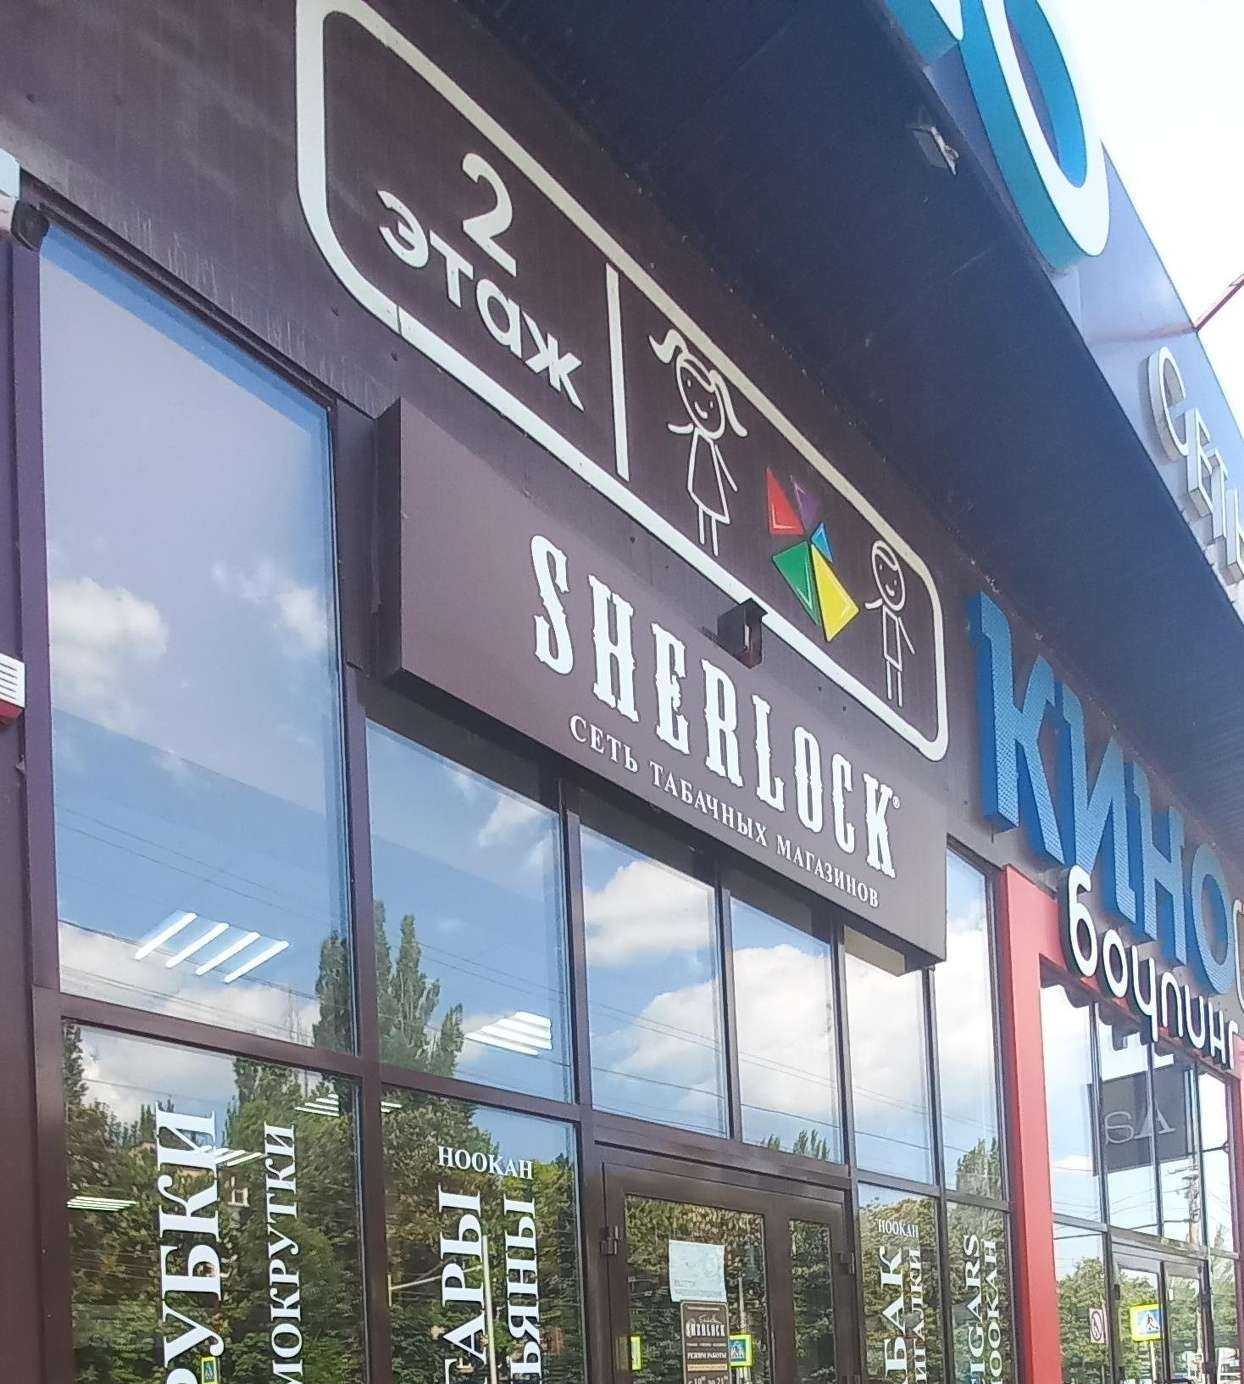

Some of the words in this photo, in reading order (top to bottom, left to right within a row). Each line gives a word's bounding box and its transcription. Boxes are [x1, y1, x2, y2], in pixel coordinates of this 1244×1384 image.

[462, 153, 517, 277] 2
[377, 190, 584, 411] этаж
[569, 714, 639, 773] СЕТЬ
[649, 760, 769, 847] ТАБАЧНЫХ
[776, 835, 880, 909] МАГАЗИНОВ
[437, 1146, 533, 1180] HOOKAH
